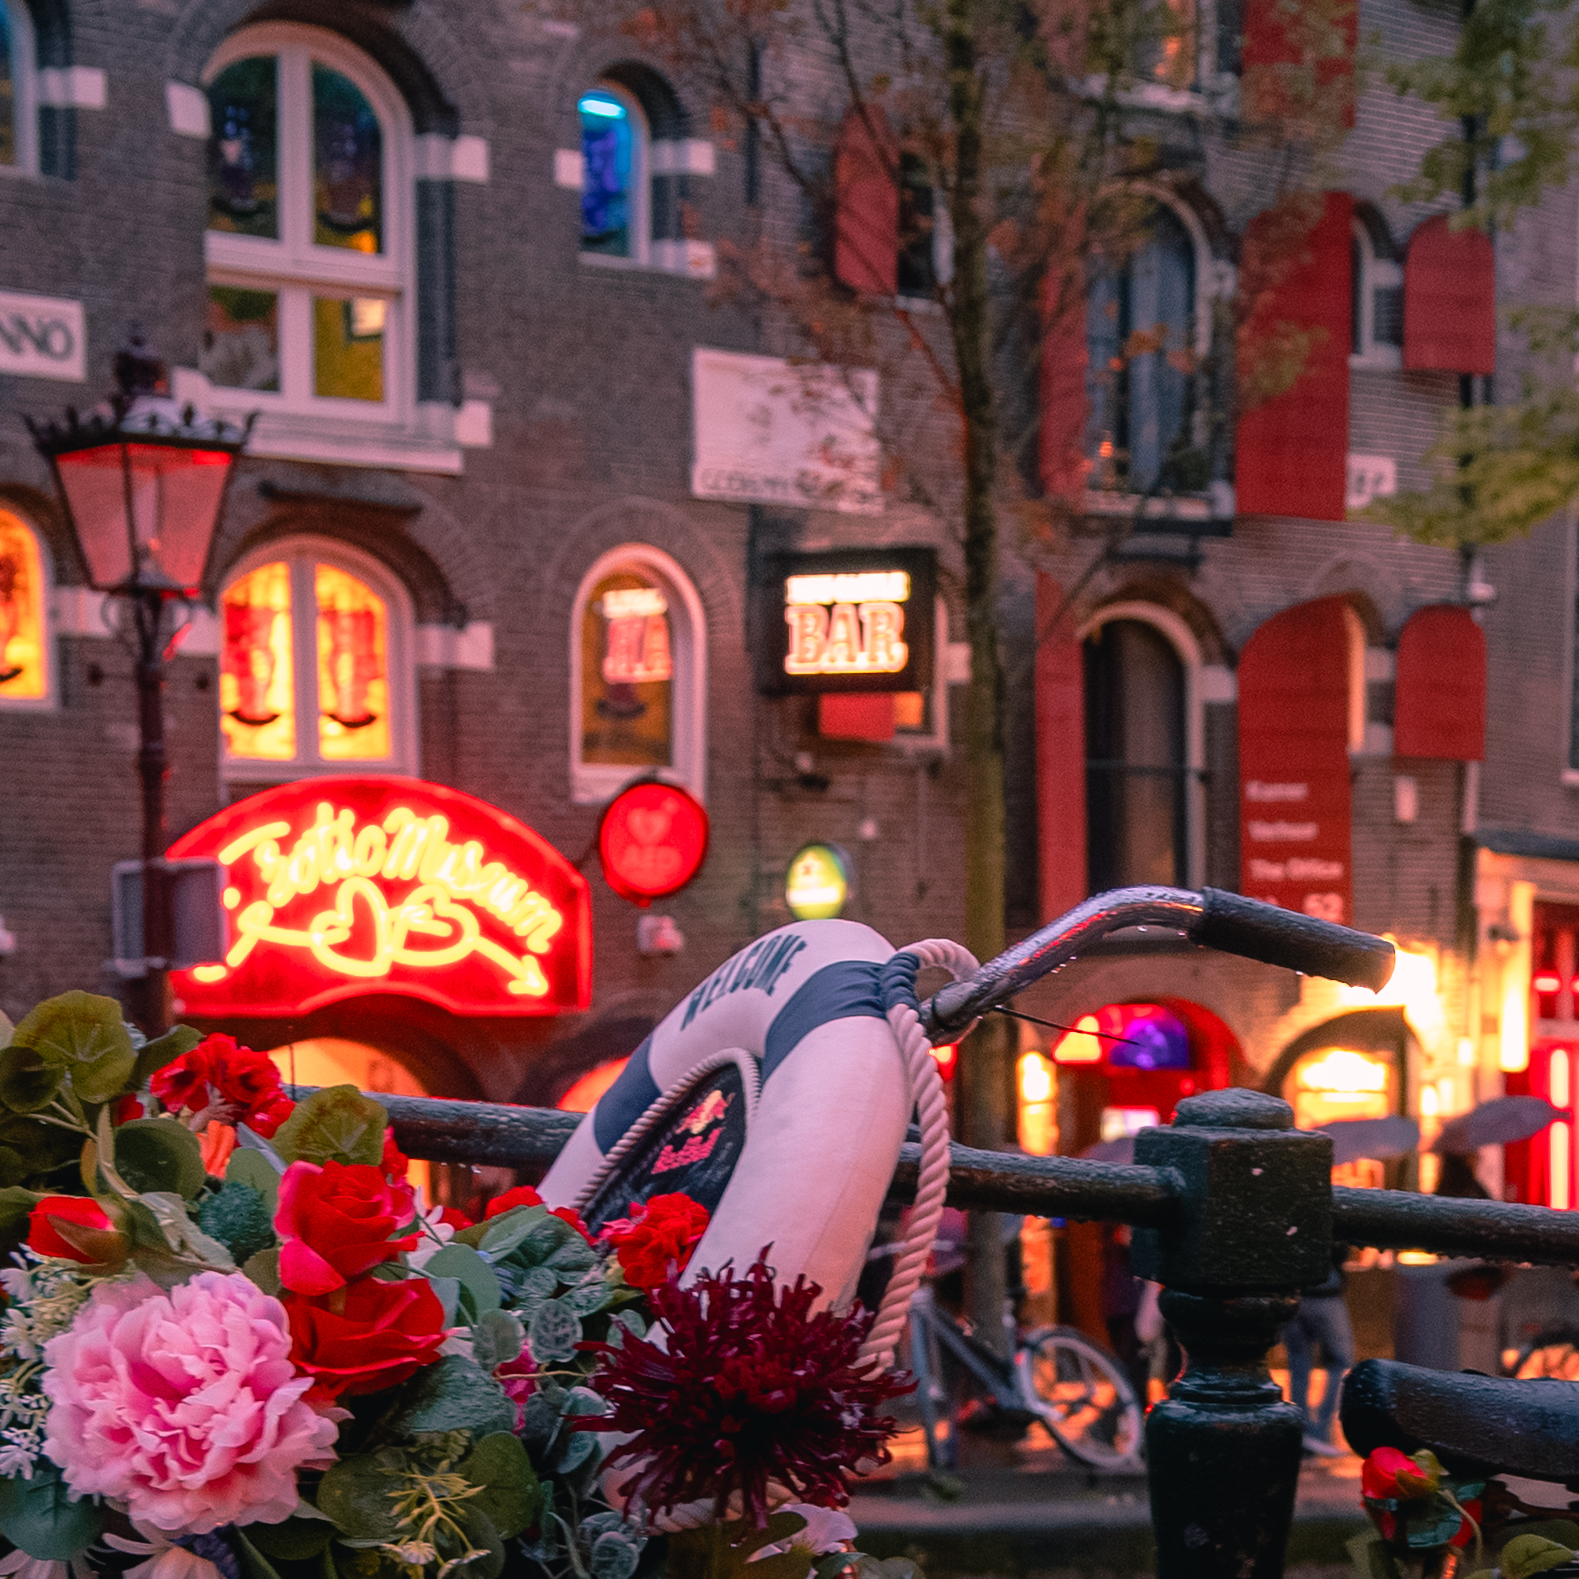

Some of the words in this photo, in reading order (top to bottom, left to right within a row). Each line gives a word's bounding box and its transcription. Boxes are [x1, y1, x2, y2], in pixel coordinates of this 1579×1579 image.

[785, 601, 908, 674] BAR
[383, 807, 562, 954] Museum
[680, 934, 807, 1031] WELCOME
